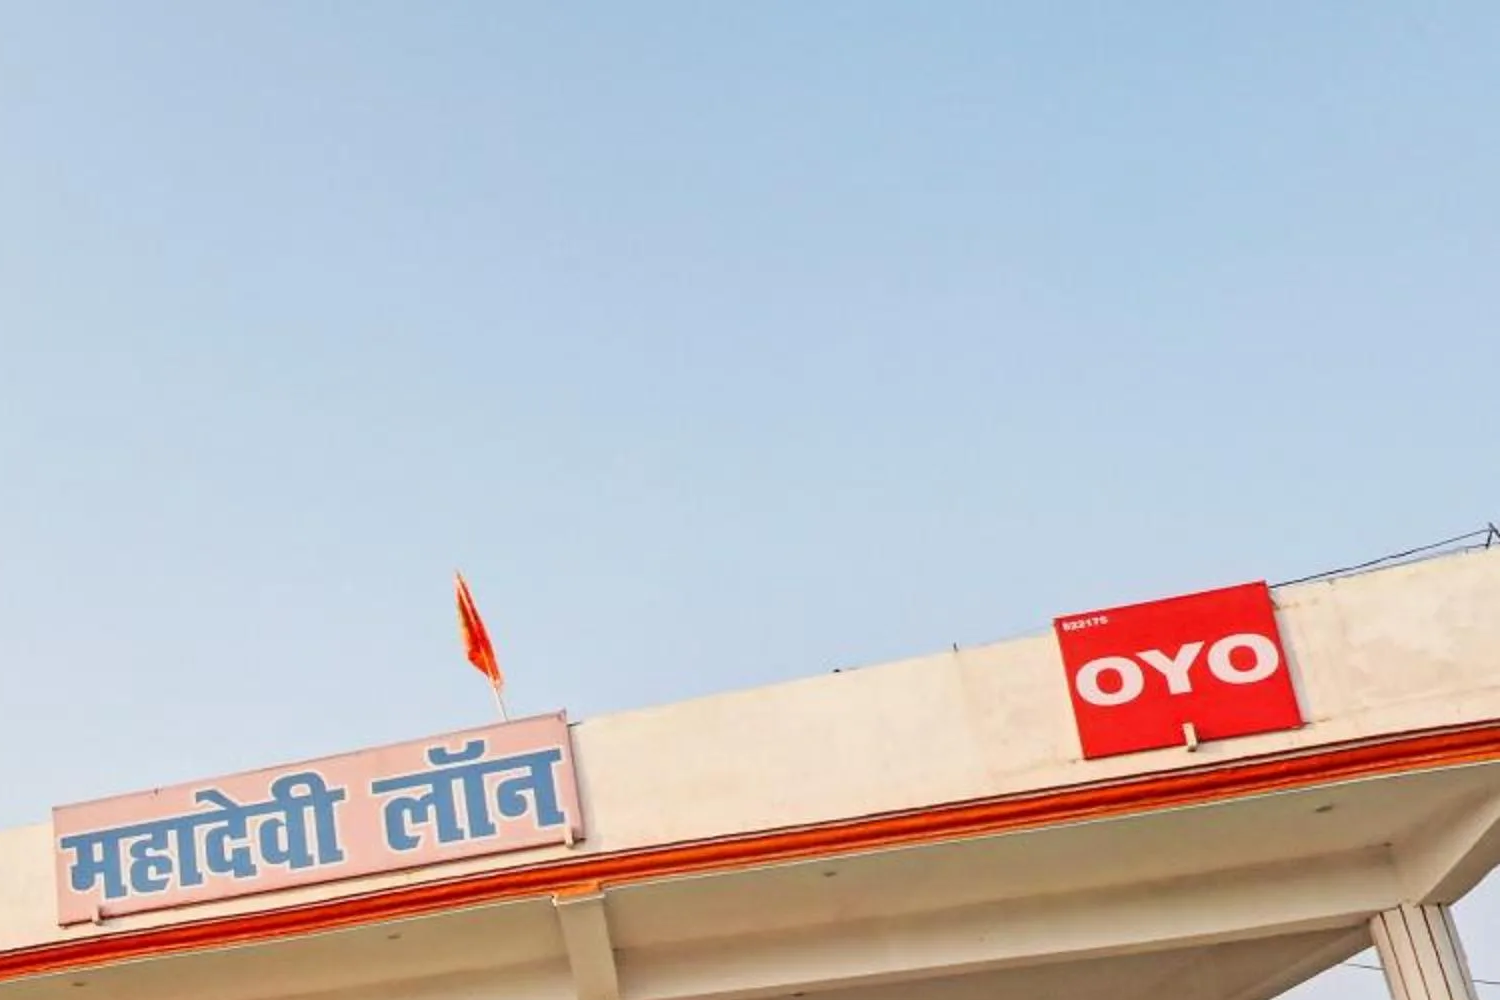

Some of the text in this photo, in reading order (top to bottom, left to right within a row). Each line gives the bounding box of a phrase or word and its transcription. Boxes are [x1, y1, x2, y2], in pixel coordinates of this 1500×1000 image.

[1075, 632, 1280, 706] OYO
[60, 740, 566, 899] महादेवी लॉन
